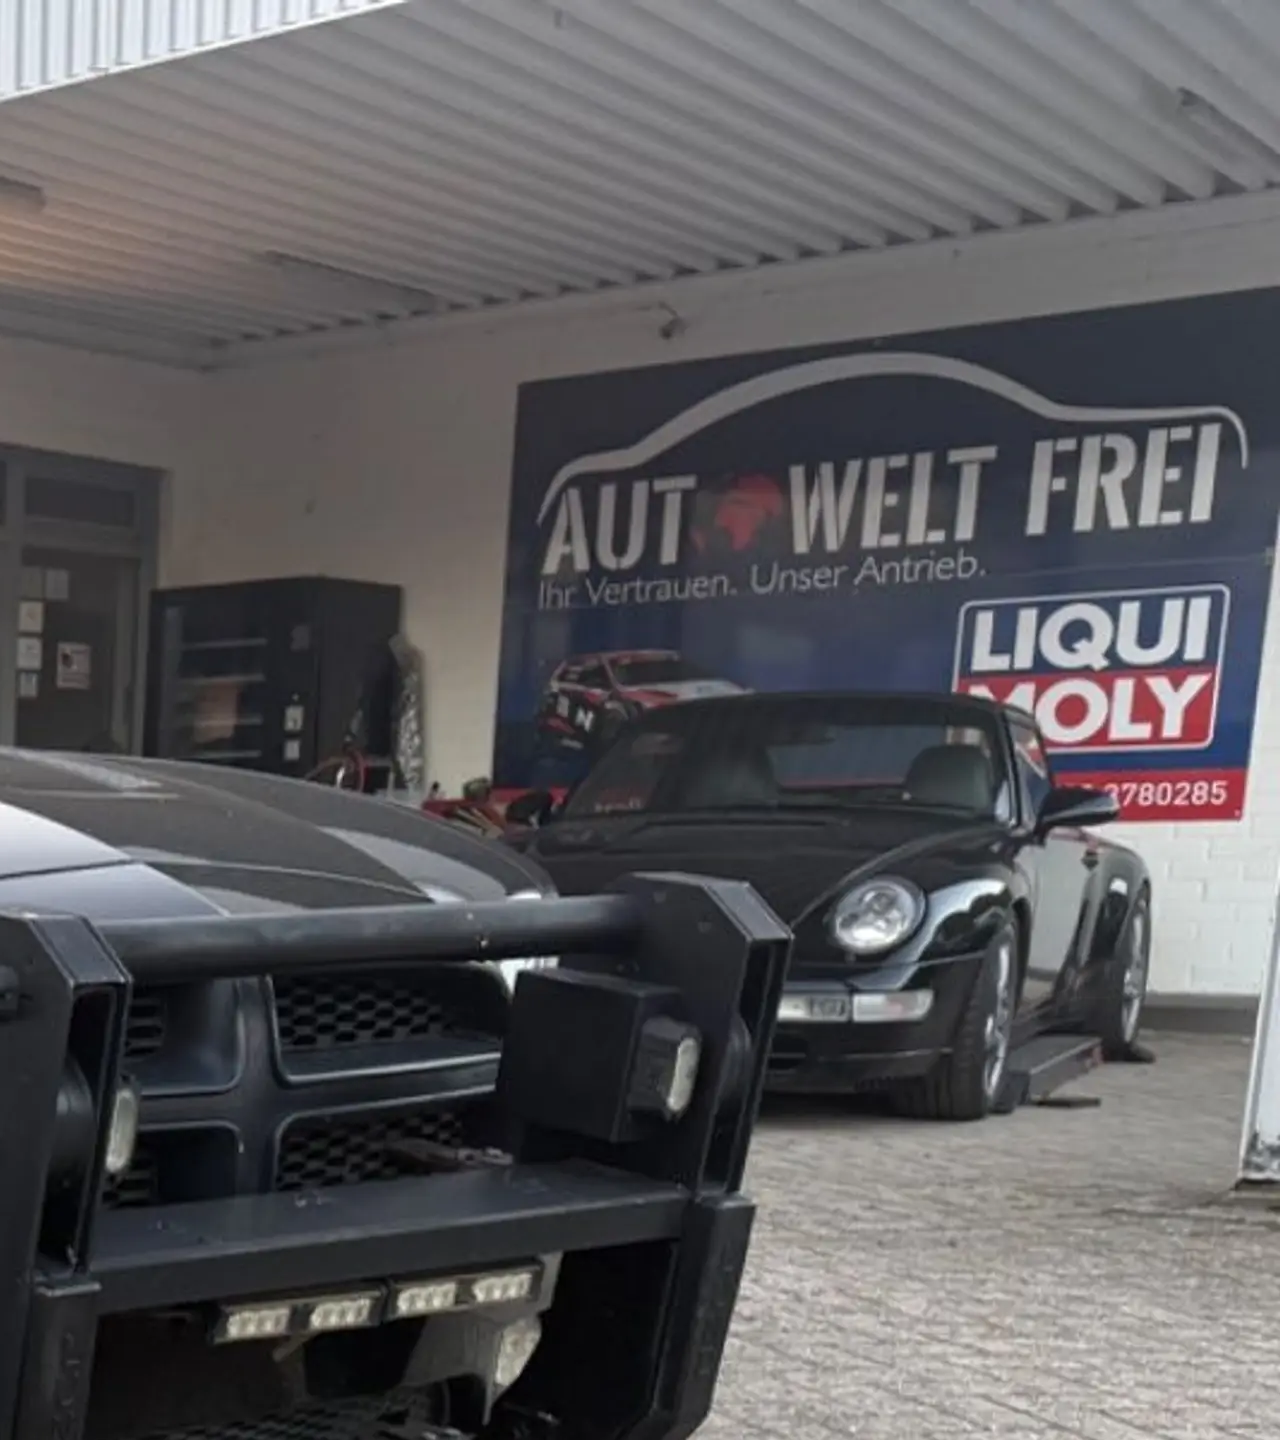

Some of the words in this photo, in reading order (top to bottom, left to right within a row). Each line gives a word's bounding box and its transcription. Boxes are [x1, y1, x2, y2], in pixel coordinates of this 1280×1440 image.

[789, 445, 998, 554] WELT
[1026, 422, 1222, 537] FREI
[538, 581, 573, 609] Ihr
[585, 573, 737, 606] Vertrauen.
[750, 561, 846, 596] Unser
[853, 546, 987, 587] Antrieb.
[971, 596, 1212, 673] LIQUI
